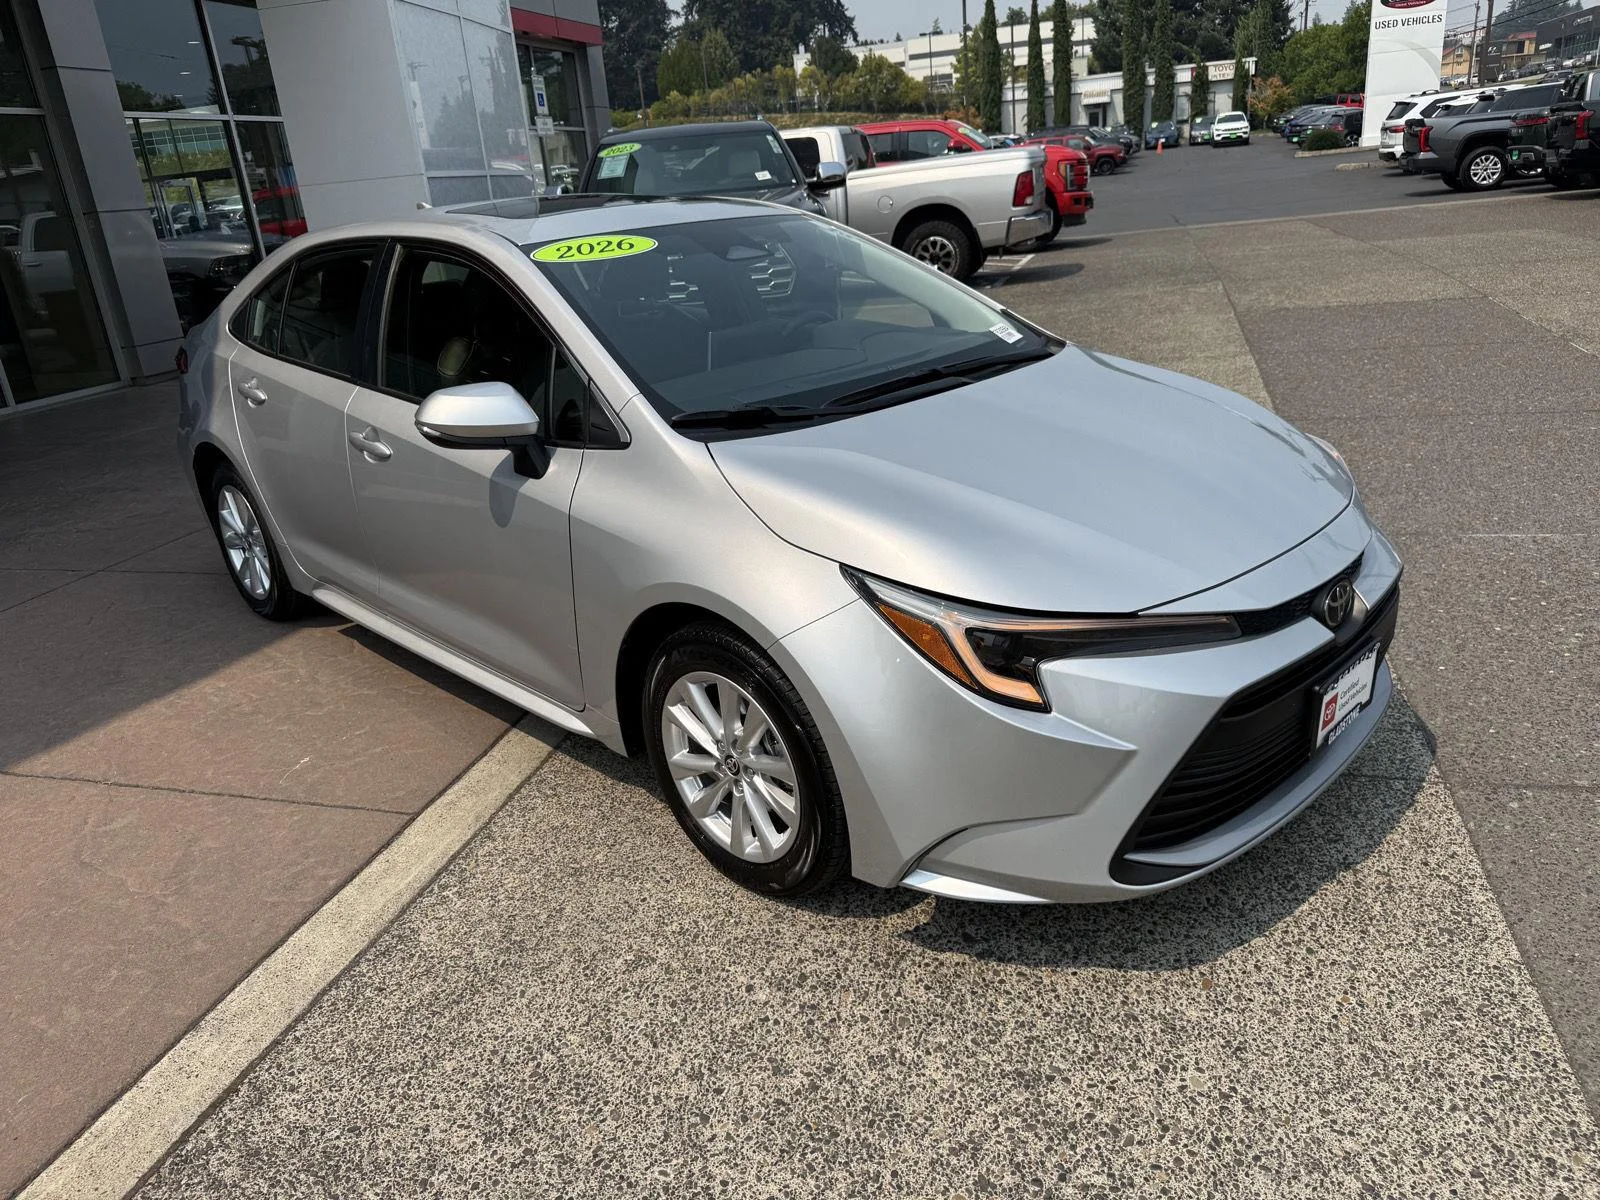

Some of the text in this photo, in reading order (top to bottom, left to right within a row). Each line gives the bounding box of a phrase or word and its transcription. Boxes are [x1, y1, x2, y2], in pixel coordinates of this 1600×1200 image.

[1374, 13, 1443, 30] USED VEHICLES
[605, 144, 635, 156] 2023
[555, 237, 635, 260] 2026
[1340, 677, 1360, 699] Certified
[1338, 695, 1351, 712] Used
[1328, 703, 1361, 745] GLADSTONE
